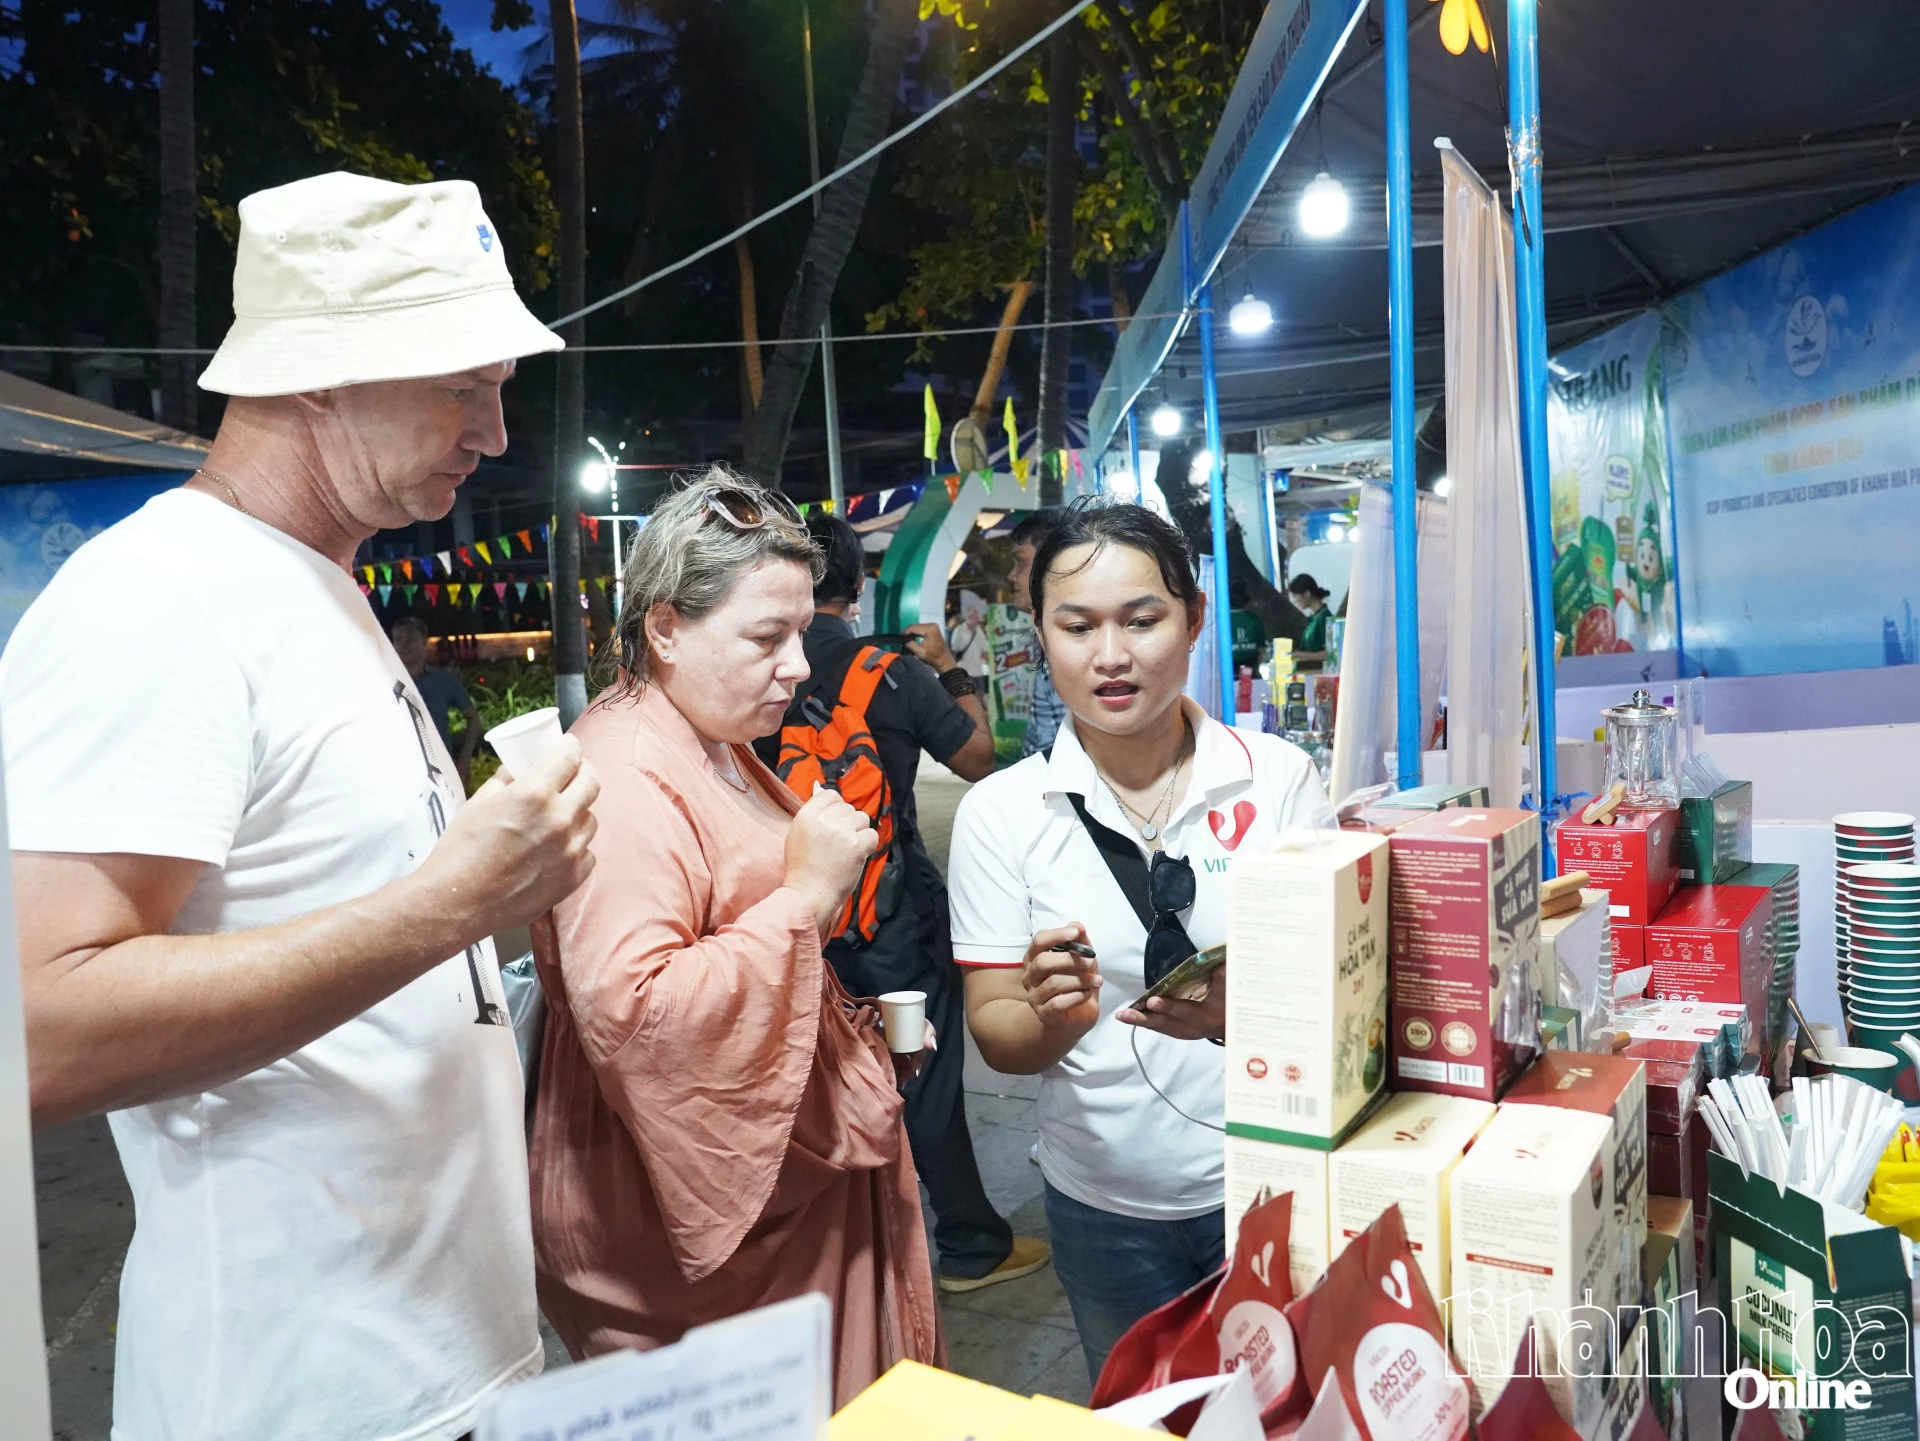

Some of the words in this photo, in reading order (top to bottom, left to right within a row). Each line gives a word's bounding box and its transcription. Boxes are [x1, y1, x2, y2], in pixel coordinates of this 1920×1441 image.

[1745, 1285, 1798, 1328] COCONUT
[1749, 1308, 1767, 1328] MILK
[1767, 1320, 1794, 1346] COFFEE
[1369, 1348, 1417, 1407] ROASTED
